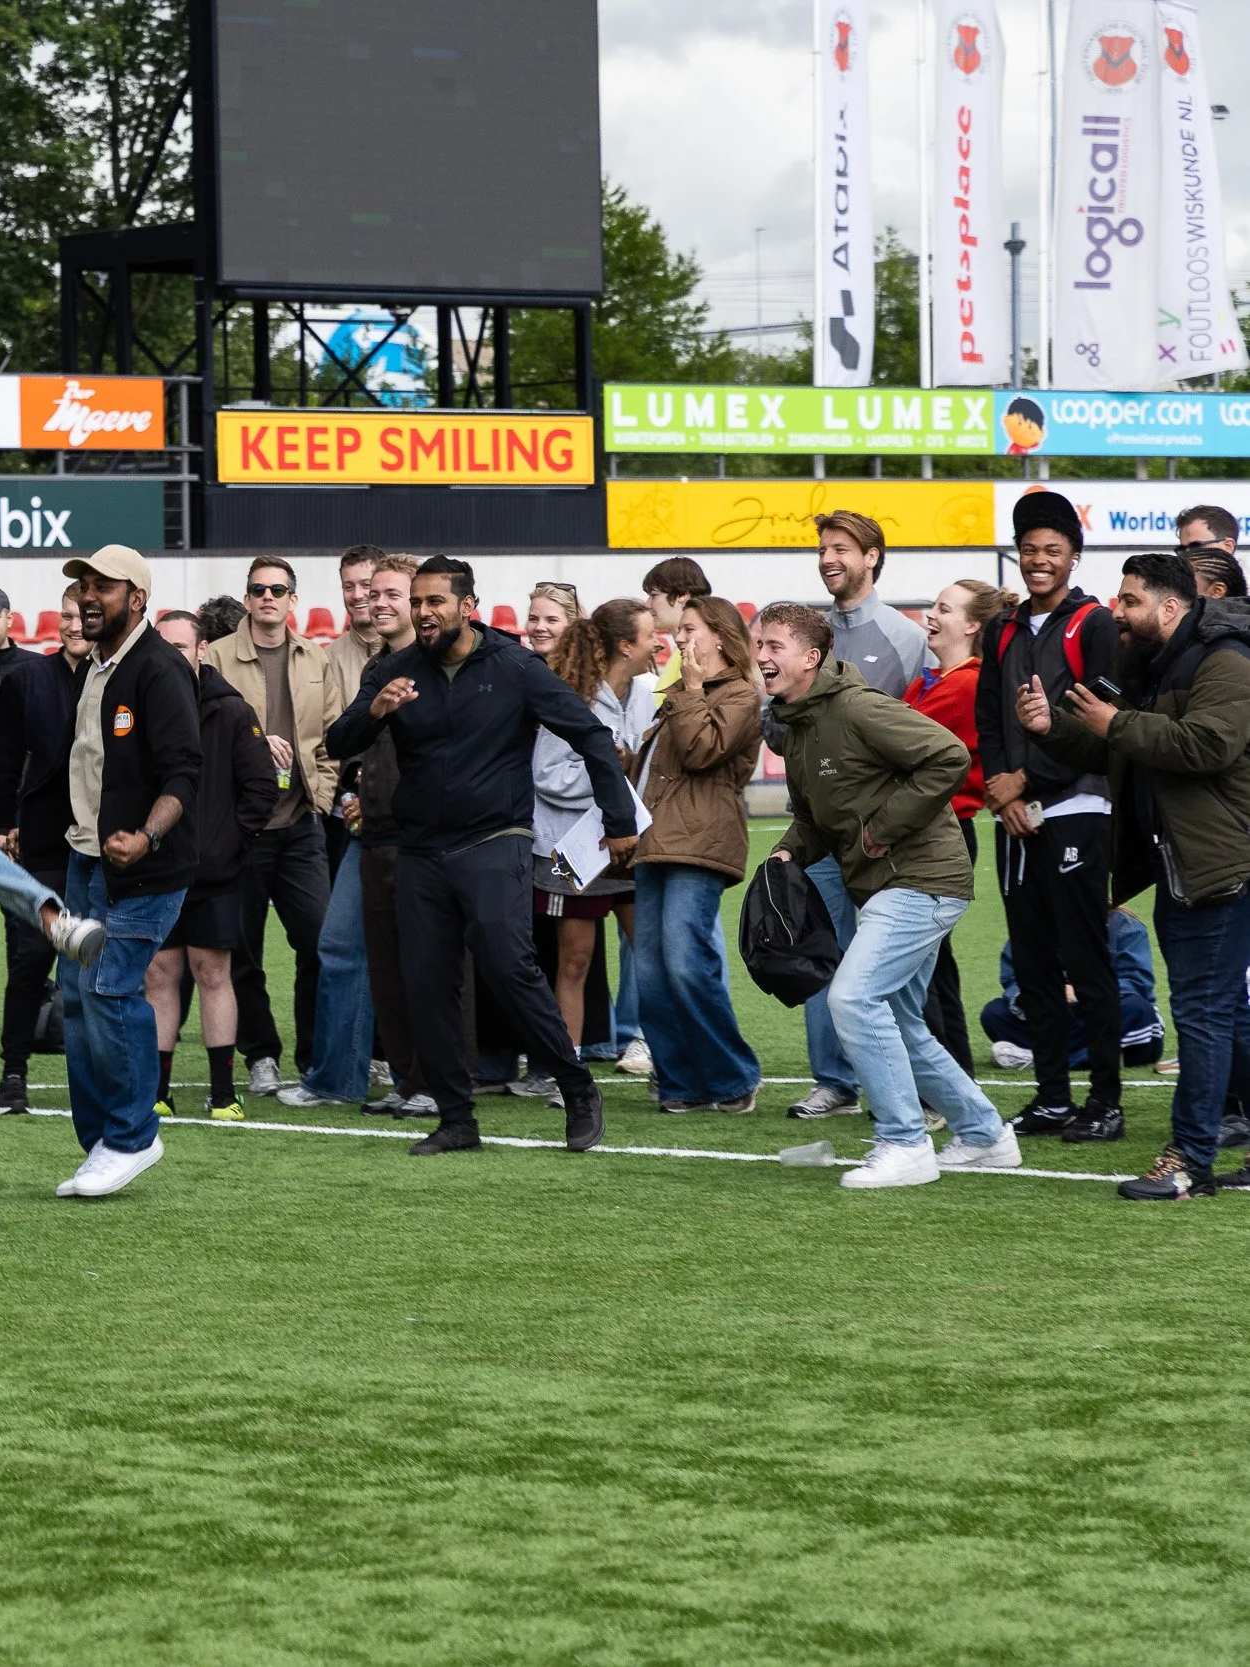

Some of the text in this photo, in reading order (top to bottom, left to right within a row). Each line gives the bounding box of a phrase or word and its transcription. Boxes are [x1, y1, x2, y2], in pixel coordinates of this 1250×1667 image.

[1073, 115, 1145, 291] logicall
[41, 398, 153, 447] Maeve
[611, 391, 787, 429] LUMEX
[824, 395, 990, 431] LUMEX
[241, 425, 574, 473] KEEP SMILING
[1063, 846, 1079, 862] AB
